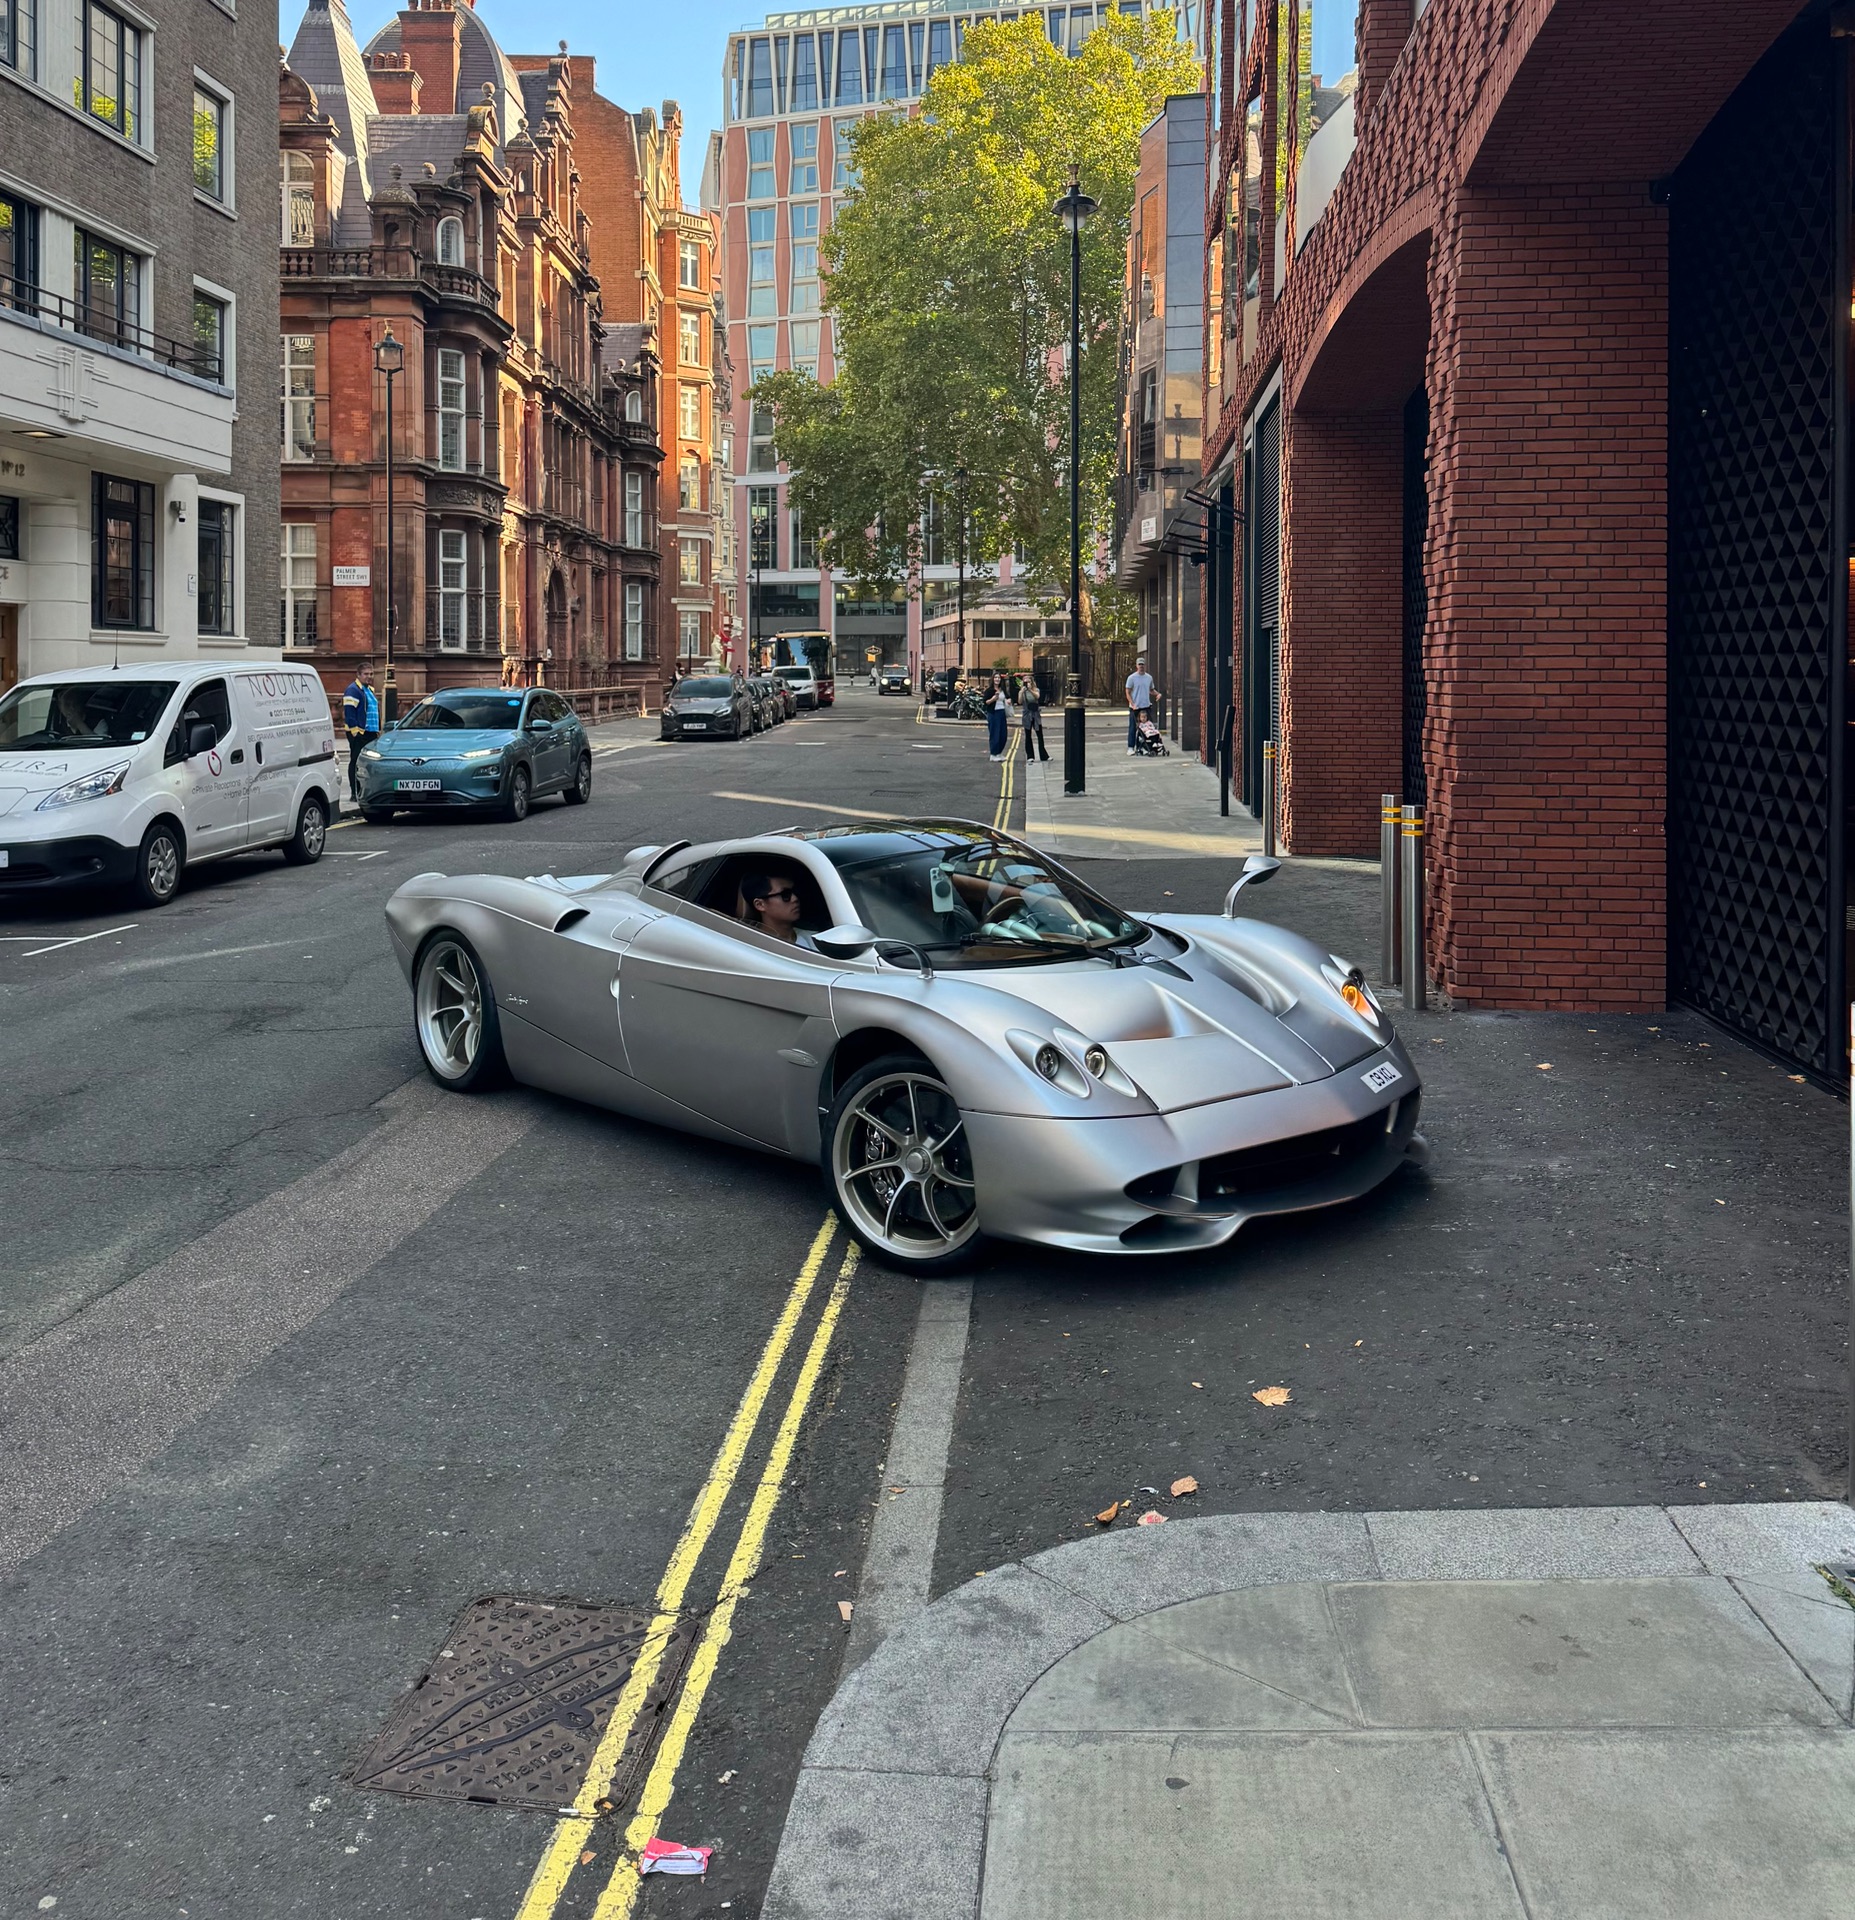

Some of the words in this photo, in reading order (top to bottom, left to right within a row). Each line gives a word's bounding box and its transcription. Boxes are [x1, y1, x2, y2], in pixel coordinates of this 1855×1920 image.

[14, 463, 25, 477] 12
[247, 673, 311, 697] NOURA
[195, 784, 213, 793] Private
[214, 779, 241, 790] Receptions
[399, 780, 421, 789] NX70
[422, 780, 440, 789] FGN
[228, 789, 242, 799] Home
[1369, 1072, 1386, 1086] C9
[510, 1613, 588, 1650] Thames
[444, 1651, 510, 1683] Water
[485, 1742, 575, 1789] Thames
